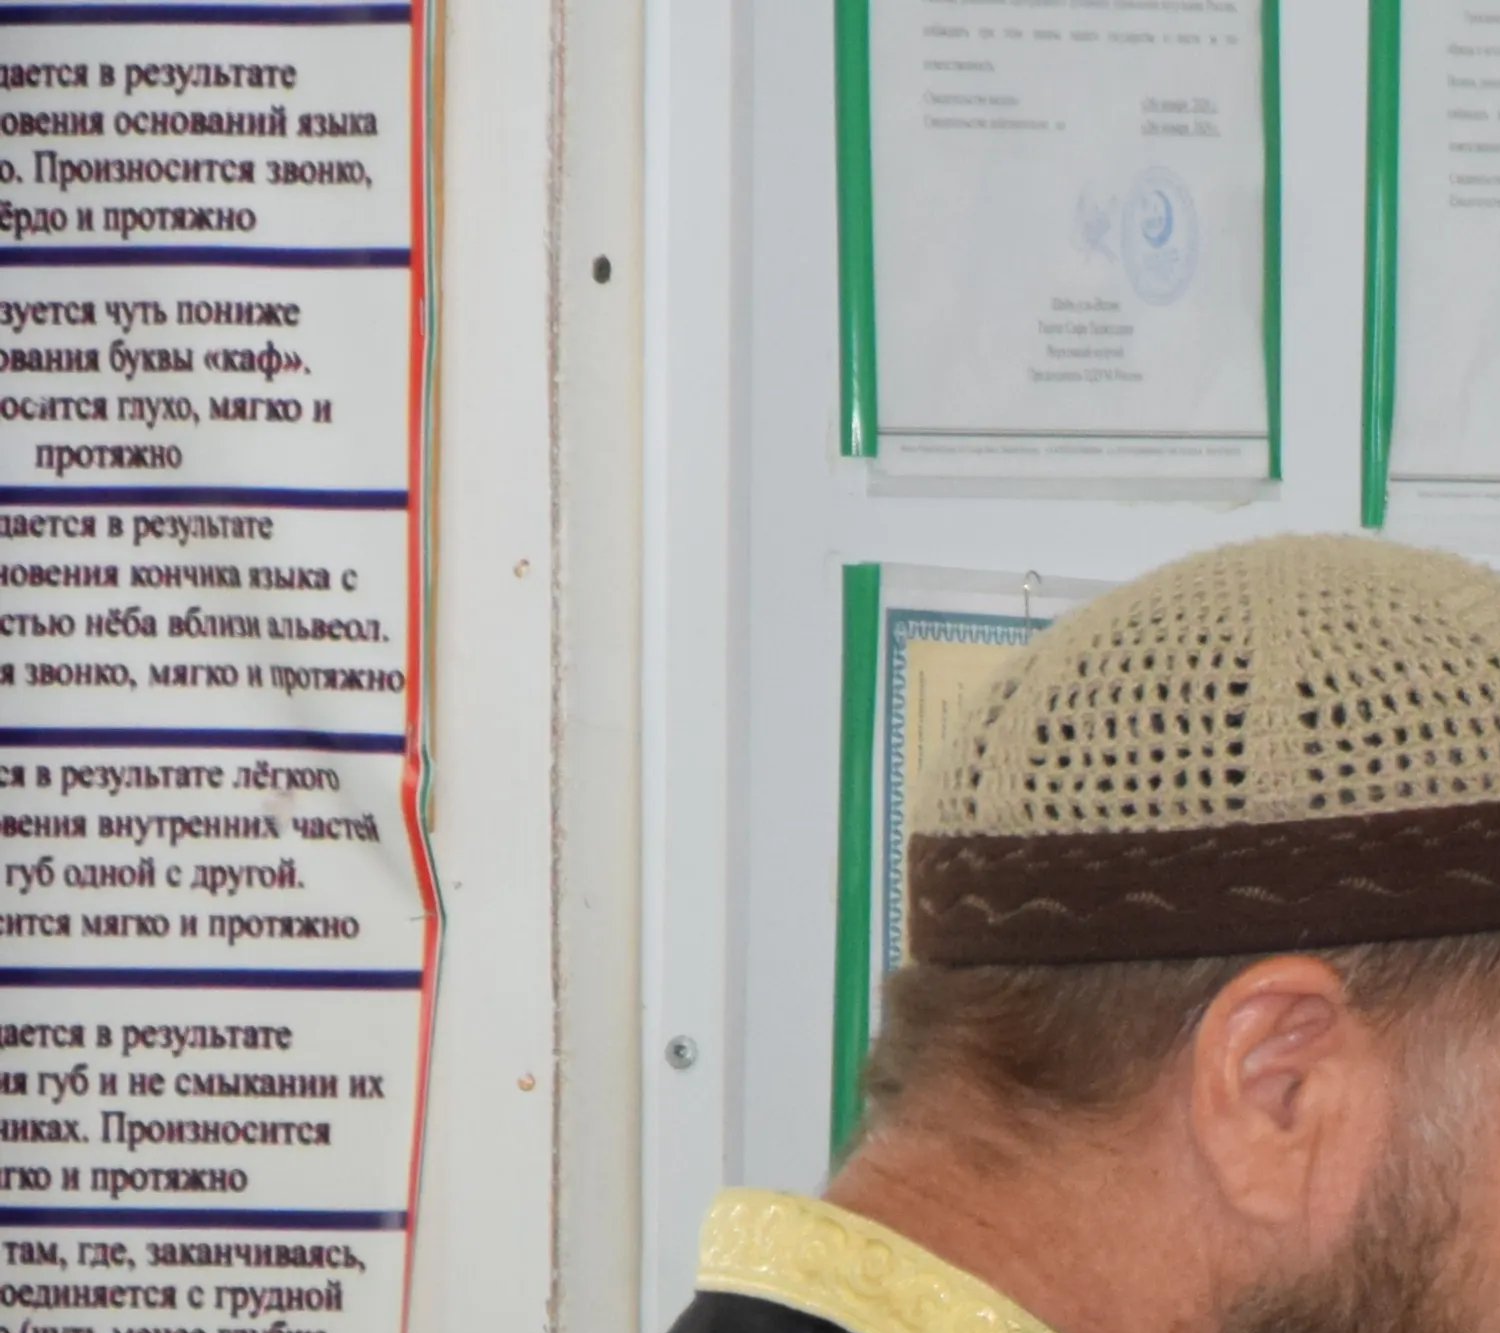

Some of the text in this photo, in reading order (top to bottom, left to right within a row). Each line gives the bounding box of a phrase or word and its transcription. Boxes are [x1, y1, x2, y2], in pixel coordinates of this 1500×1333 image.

[99, 63, 116, 88] в
[124, 62, 298, 97] результате
[113, 104, 288, 138] оснований
[296, 112, 379, 138] языка
[33, 150, 254, 192] Произносится
[266, 160, 373, 189] звонко,
[76, 207, 95, 232] и
[102, 206, 257, 241] протяжно
[104, 300, 168, 335] чуть
[176, 300, 301, 328] пониже
[108, 338, 194, 382] буквы
[203, 339, 312, 383] «каф».
[117, 395, 201, 430] глухо,
[209, 396, 303, 423] мягко
[312, 399, 333, 424] и
[35, 444, 183, 479] протяжно
[107, 514, 125, 539] в
[132, 514, 274, 548] результате
[130, 564, 243, 589] кончика
[248, 566, 332, 592] языка
[340, 568, 359, 593] с
[85, 605, 158, 638] нёба
[167, 605, 262, 640] вблизи
[266, 615, 390, 643] альвеол.
[24, 662, 138, 689] звонко,
[149, 663, 240, 688] мягко
[246, 664, 264, 688] и
[270, 665, 407, 699] протяжно
[35, 765, 52, 789] в
[60, 764, 225, 798] результате
[232, 760, 341, 793] лёгкого
[0, 812, 381, 848] вения внутренних частей
[5, 855, 305, 897] губ одной с другой.
[81, 913, 171, 938] мягко
[179, 914, 198, 938] и
[208, 914, 360, 947] протяжно
[0, 1023, 293, 1059] ается в результате
[37, 1062, 90, 1106] губ
[98, 1072, 118, 1097] и
[128, 1072, 166, 1097] не
[174, 1072, 339, 1099] смыкании
[348, 1074, 385, 1100] их
[100, 1110, 331, 1153] Произносится
[60, 1166, 81, 1192] и
[90, 1167, 249, 1201] протяжно
[5, 1241, 366, 1272] там, где, заканчиваясь,
[186, 1285, 205, 1310] с
[214, 1279, 344, 1320] грудной
